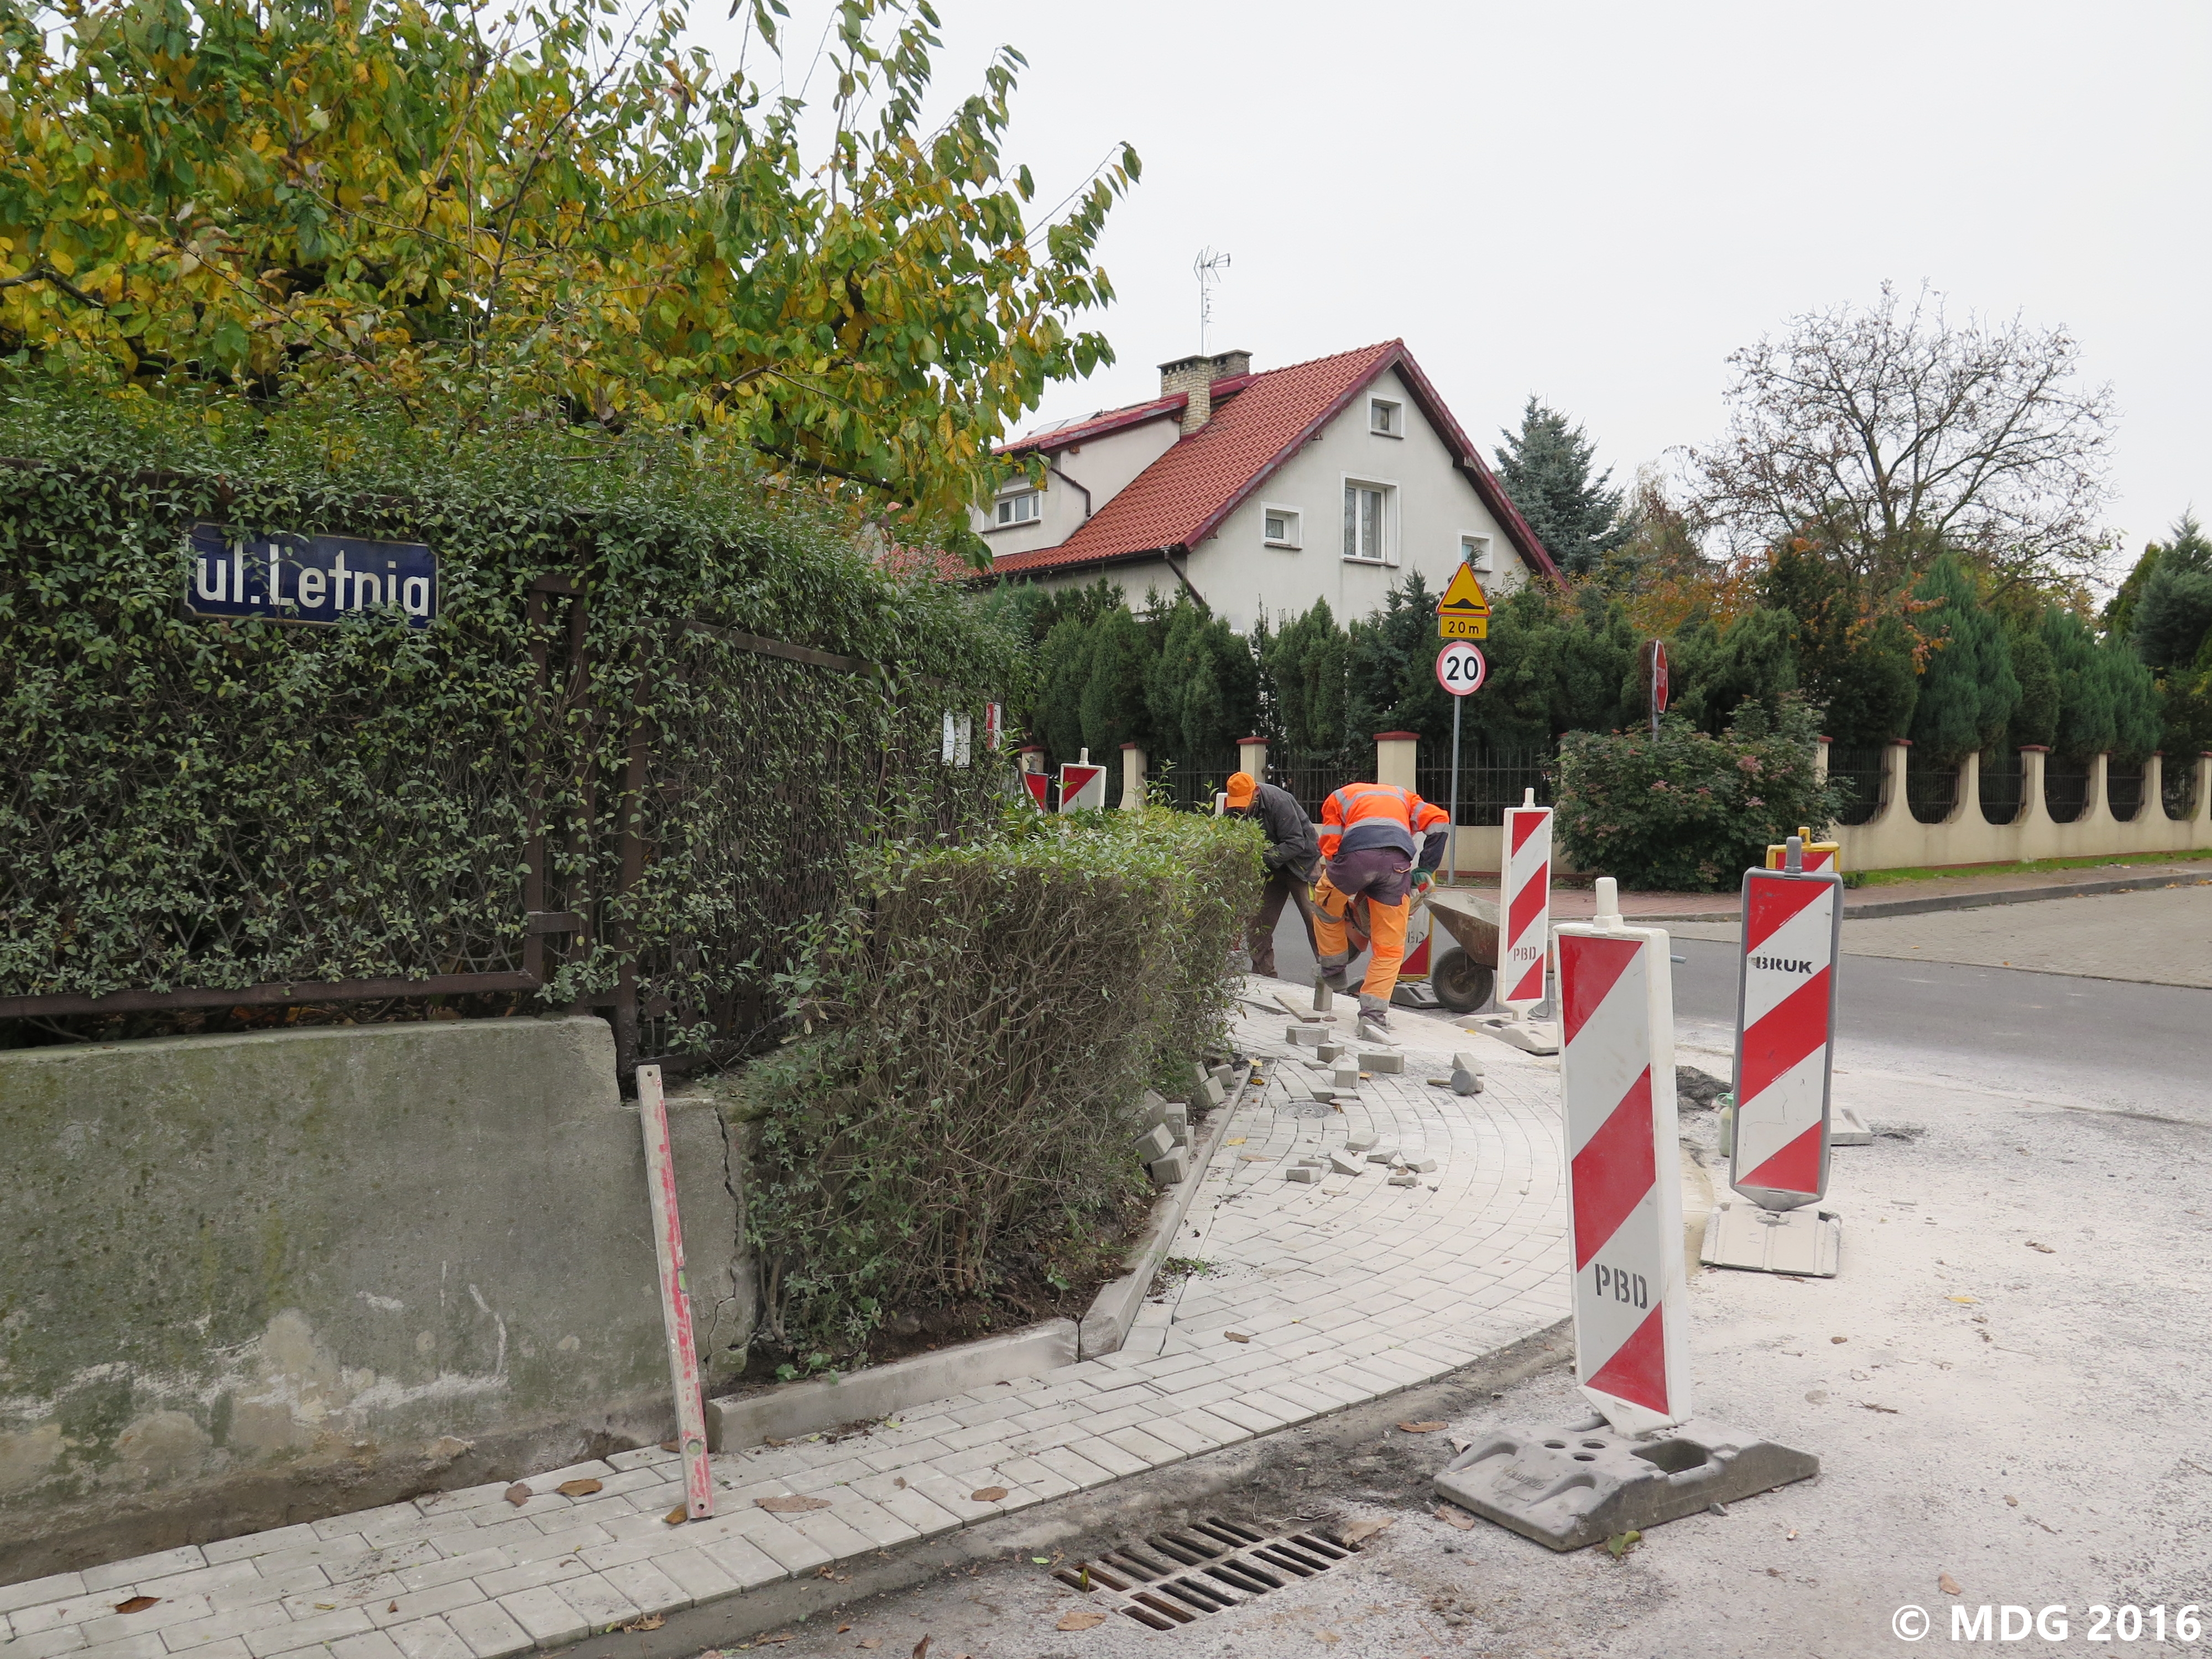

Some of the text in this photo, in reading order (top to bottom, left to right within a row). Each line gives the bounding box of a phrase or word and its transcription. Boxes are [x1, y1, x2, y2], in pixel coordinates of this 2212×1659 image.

[1446, 656, 1479, 681] 20
[1514, 946, 1536, 962] PBD
[1756, 956, 1813, 974] BRUK
[1595, 1264, 1647, 1310] PBD
